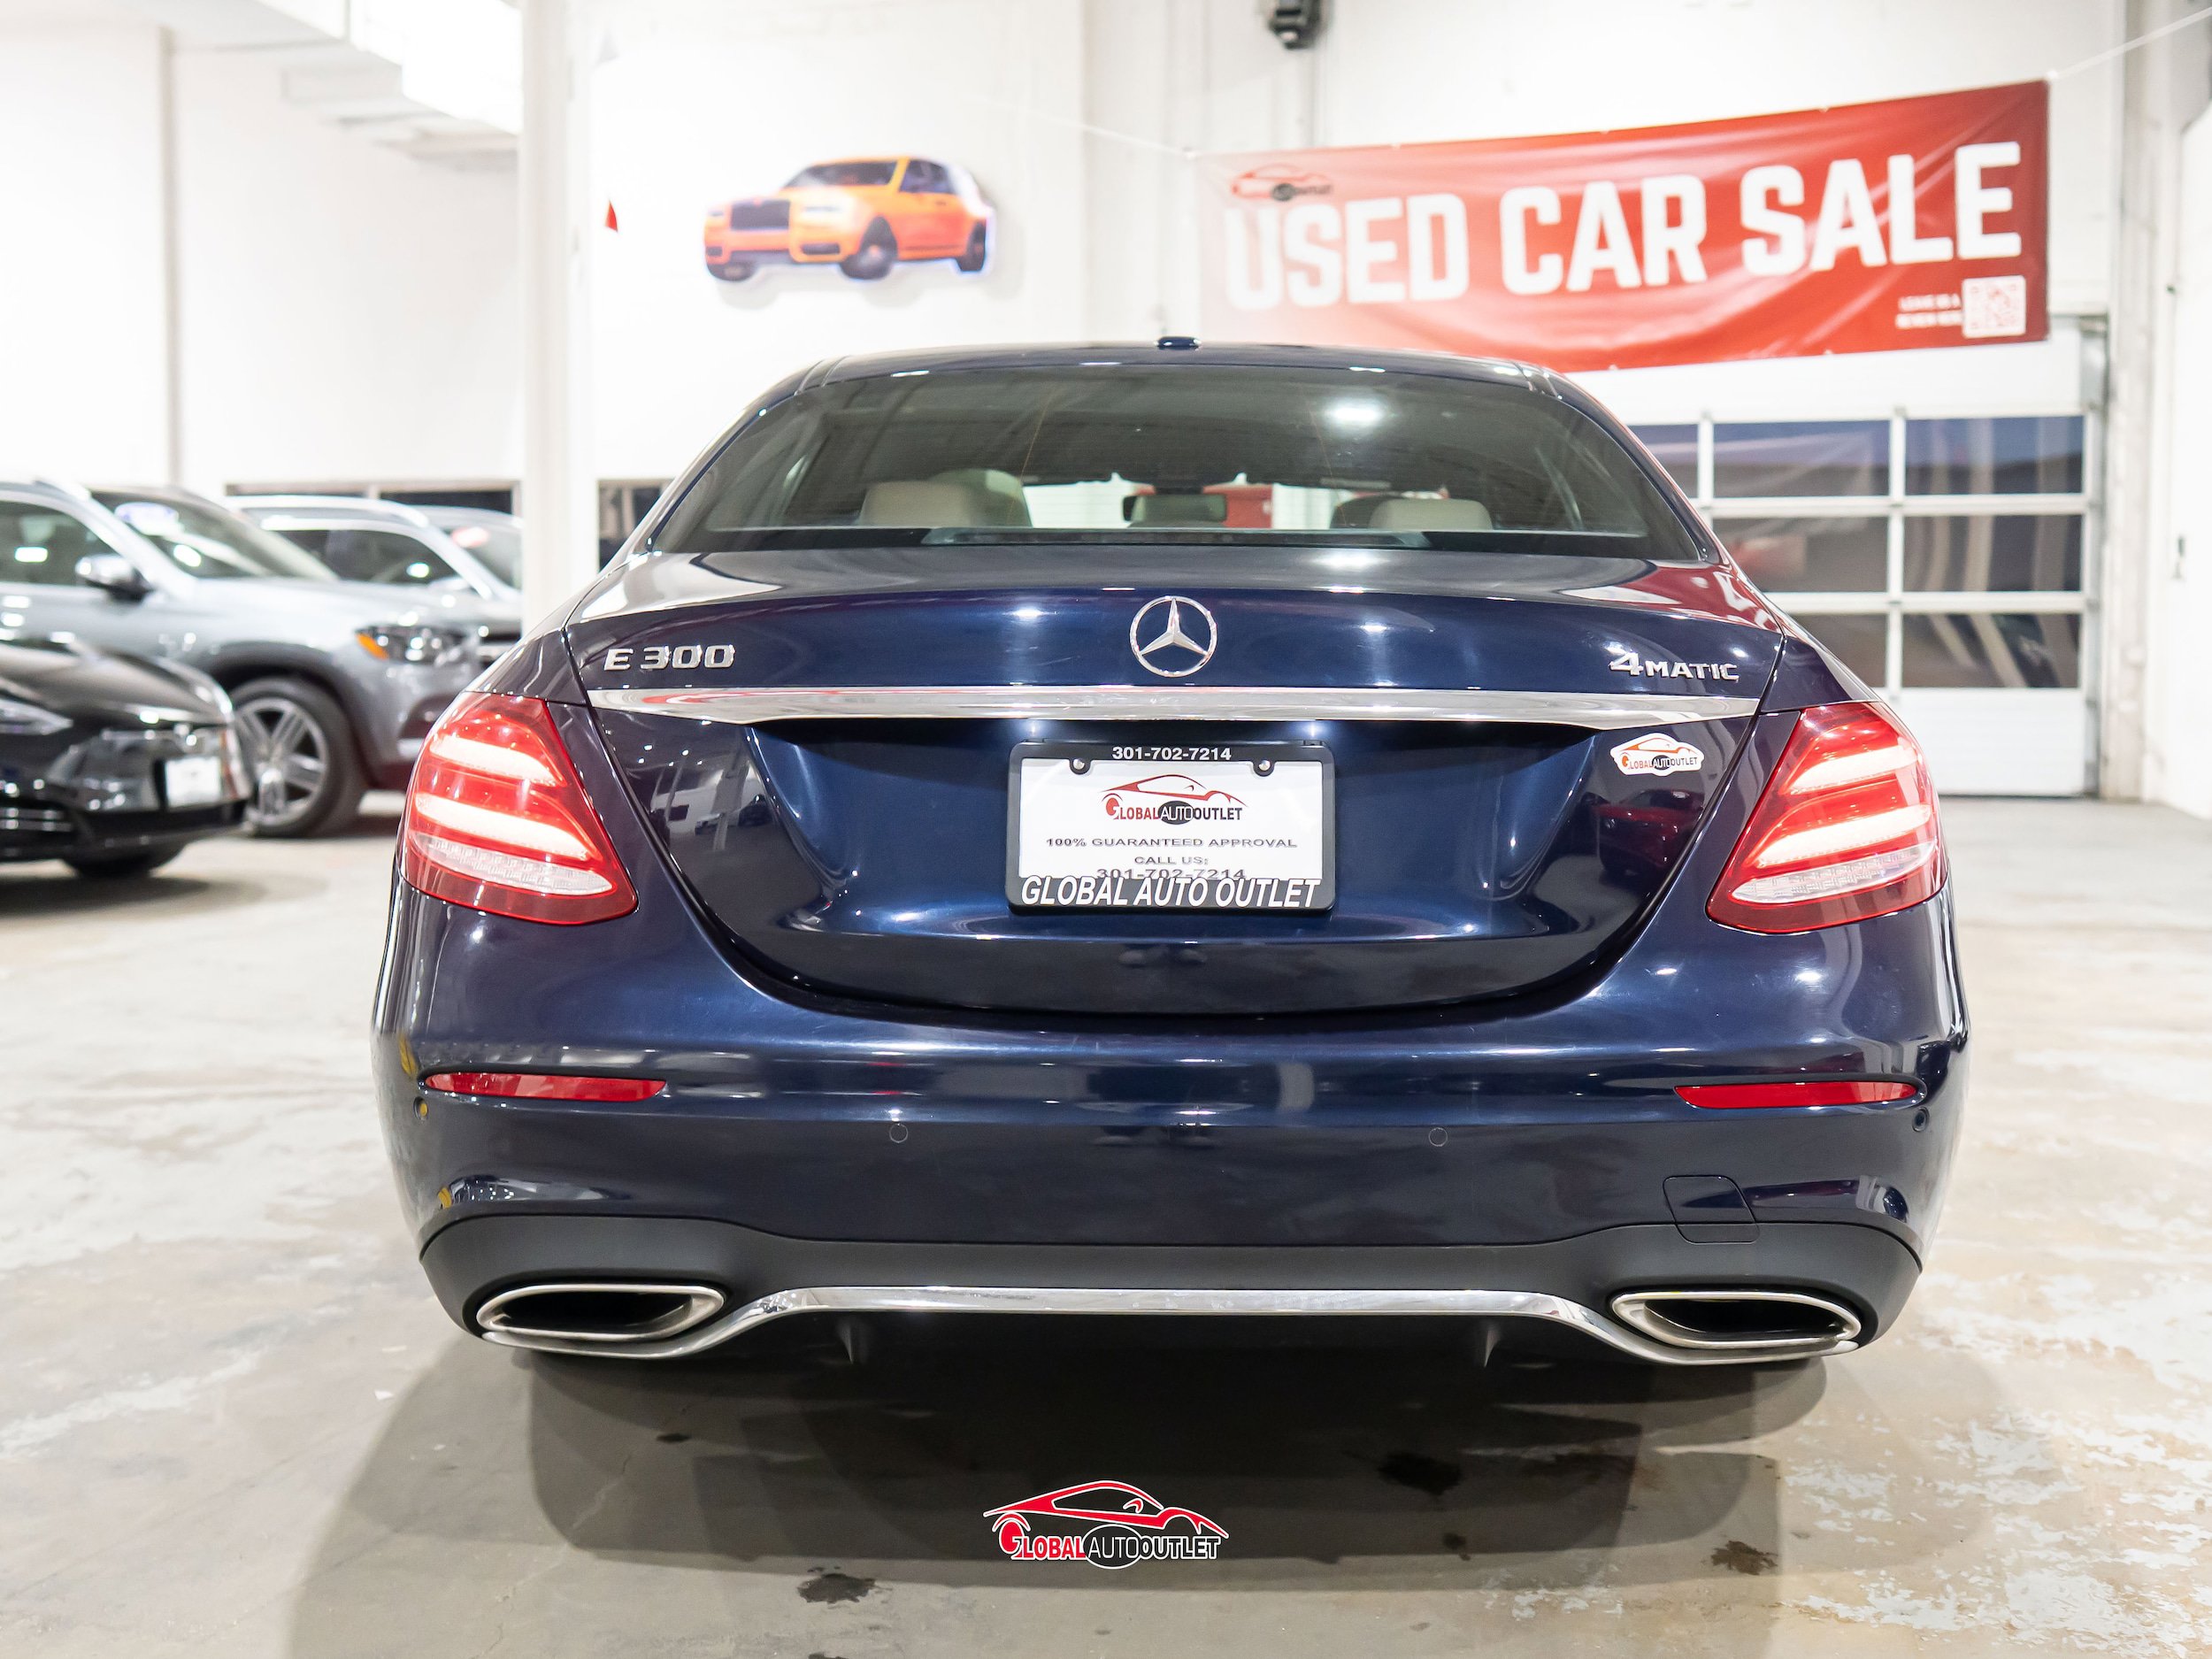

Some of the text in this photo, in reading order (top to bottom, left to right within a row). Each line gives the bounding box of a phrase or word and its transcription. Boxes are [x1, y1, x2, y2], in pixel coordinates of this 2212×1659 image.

[1225, 141, 2023, 311] USED CAR SALE
[604, 644, 735, 671] E 300
[1609, 651, 1740, 680] 4MATIC
[1111, 746, 1232, 760] 301-702-7214
[1046, 838, 1298, 848] 100% GUARANTEED APPROVAL
[1133, 856, 1177, 865] CALL
[1095, 869, 1246, 879] 301-702-7214
[1021, 876, 1323, 908] GLOBAL AUTO OUTLET
